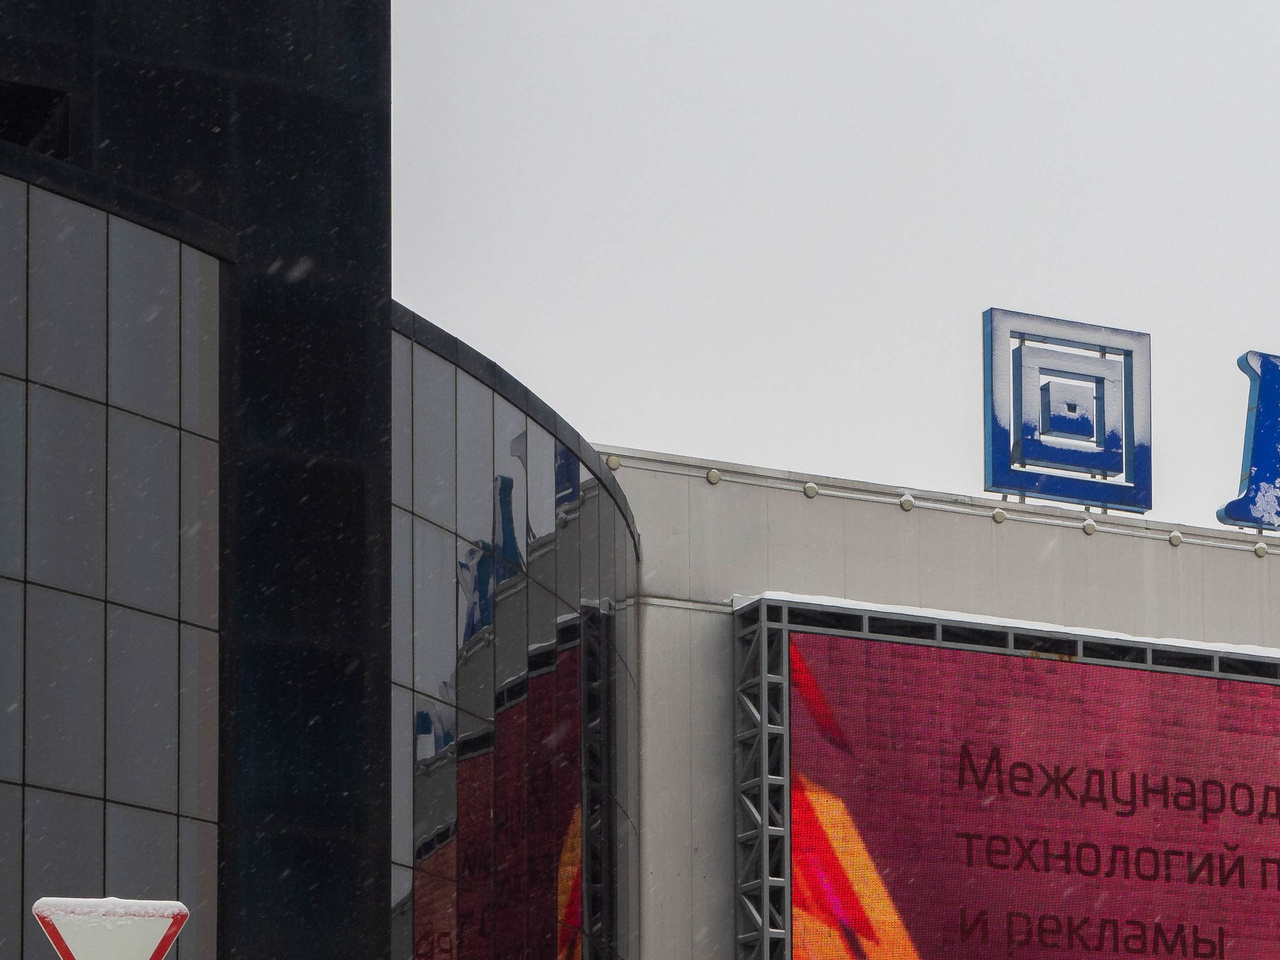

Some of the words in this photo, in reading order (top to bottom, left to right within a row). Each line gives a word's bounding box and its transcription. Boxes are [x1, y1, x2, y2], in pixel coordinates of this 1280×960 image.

[956, 831, 1245, 889] технологий
[958, 907, 989, 946] и
[1006, 910, 1225, 960] рекламы
